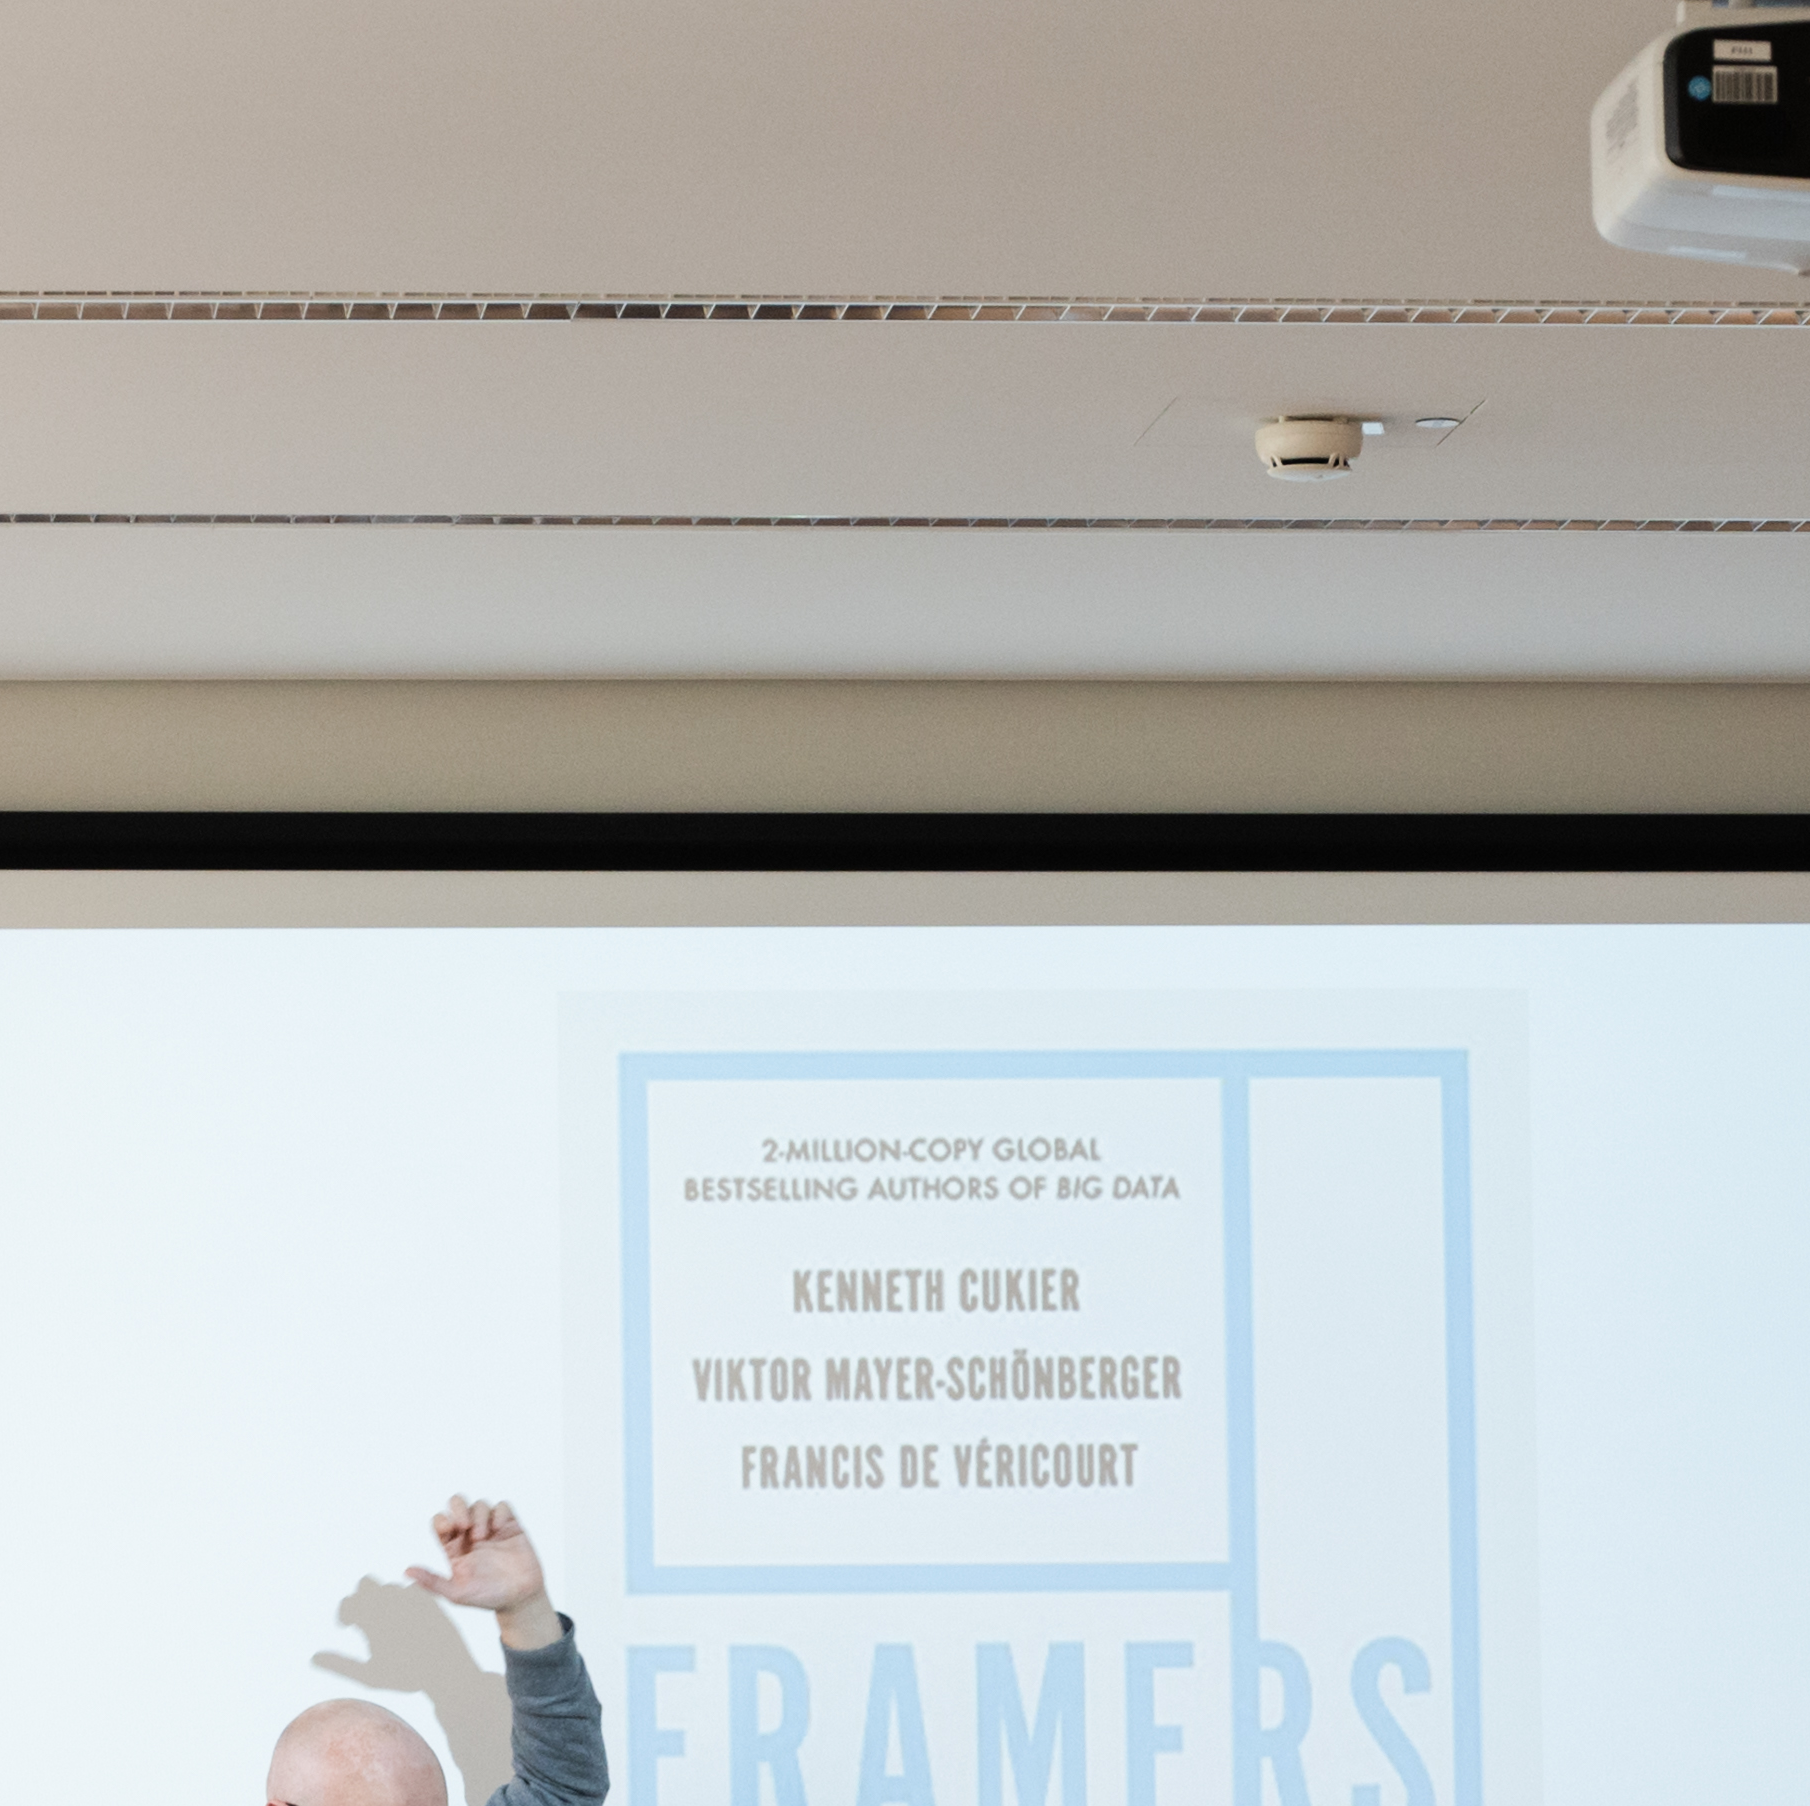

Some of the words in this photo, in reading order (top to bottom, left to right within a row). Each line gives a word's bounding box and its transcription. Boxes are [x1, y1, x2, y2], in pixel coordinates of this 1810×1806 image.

[762, 1137, 984, 1163] 2-MILLION-COPY
[992, 1136, 1101, 1162] GLOBAL
[684, 1176, 858, 1202] BESTSELLING
[867, 1176, 998, 1201] AUTHORS
[1008, 1175, 1046, 1201] OF
[1056, 1175, 1103, 1200] BIG
[1112, 1175, 1180, 1200] DATA
[793, 1269, 944, 1313] KENNETH
[959, 1268, 1080, 1313] CUKIER
[692, 1357, 812, 1402] VIKTOR
[826, 1348, 1182, 1401] MAYER-SCHÖNBERGER
[742, 1444, 884, 1489] FRANCIS
[900, 1444, 939, 1488] DE
[953, 1437, 1138, 1488] VÉRICOURT
